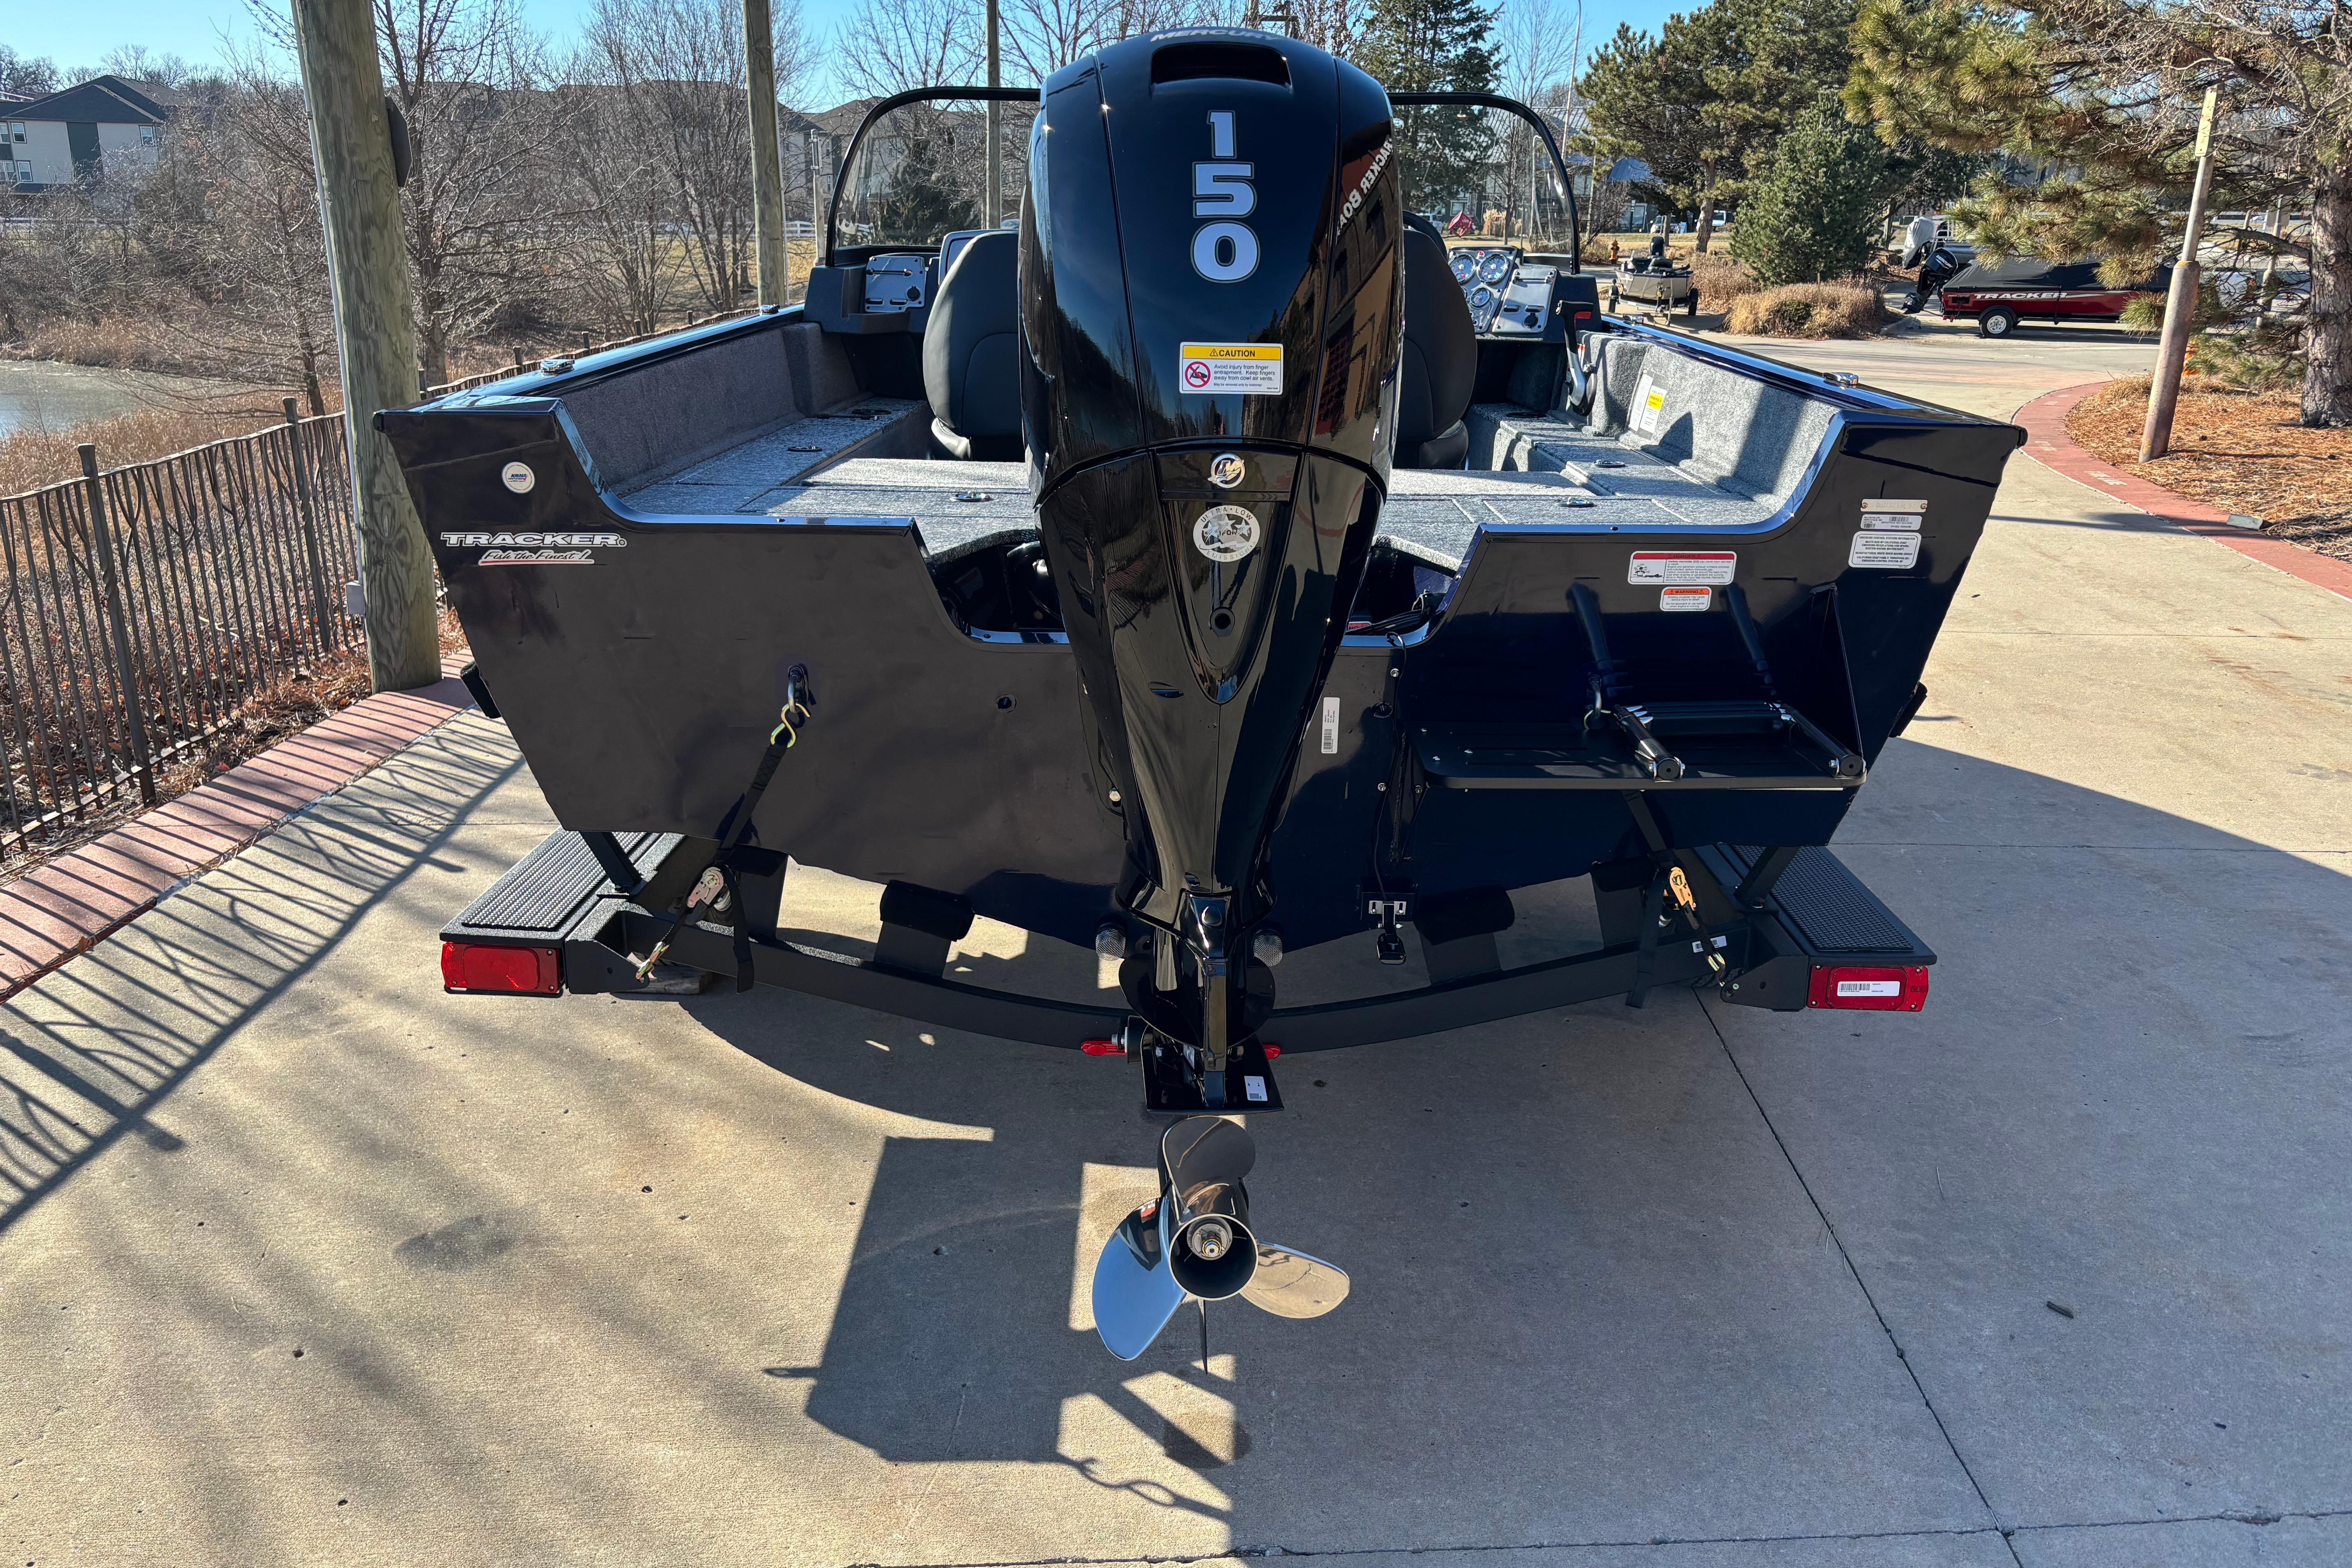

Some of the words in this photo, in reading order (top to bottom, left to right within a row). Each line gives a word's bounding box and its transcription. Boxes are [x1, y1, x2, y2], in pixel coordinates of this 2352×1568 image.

[1150, 30, 1281, 42] MERCURY
[1192, 111, 1259, 282] 150
[1201, 507, 1227, 523] ULTRA
[1235, 508, 1253, 520] LOW
[443, 534, 620, 546] TRACKER
[484, 551, 511, 560] Fish
[513, 551, 534, 560] the
